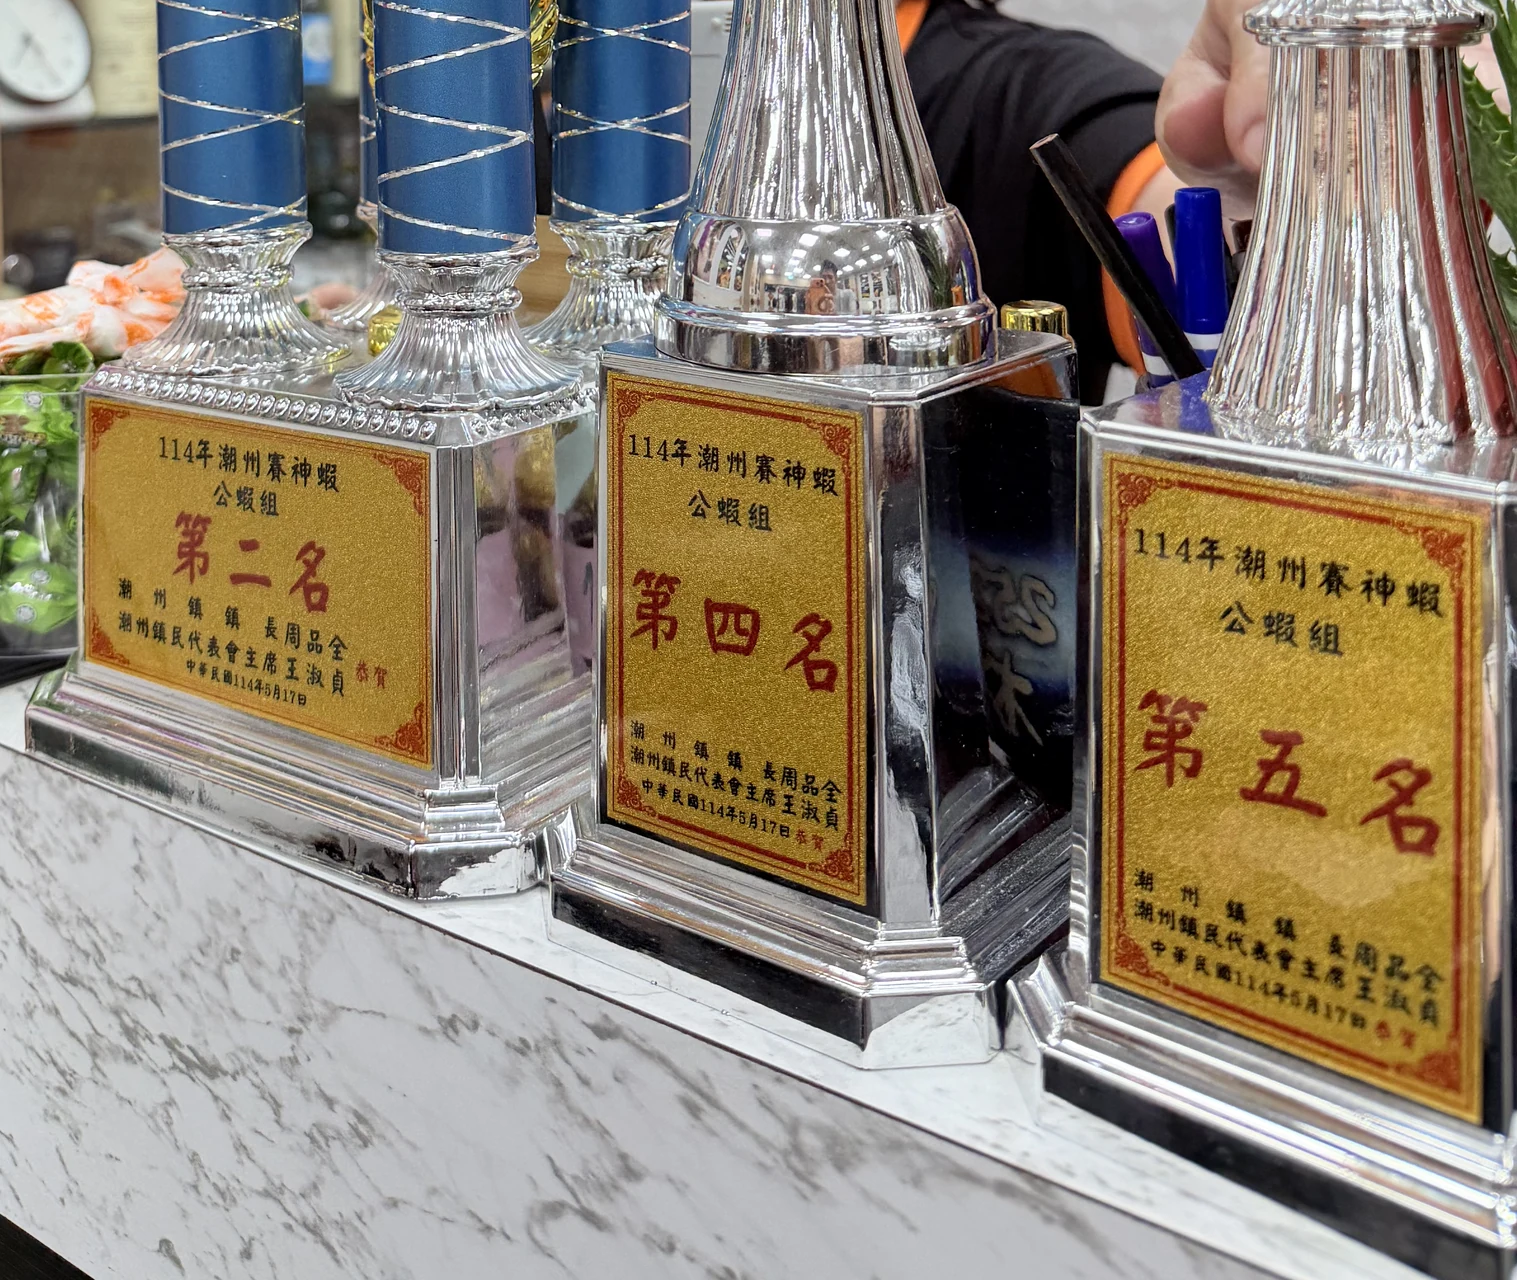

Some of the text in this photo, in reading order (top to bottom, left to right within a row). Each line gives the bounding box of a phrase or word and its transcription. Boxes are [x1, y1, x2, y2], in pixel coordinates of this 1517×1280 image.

[159, 436, 339, 493] 114年潮州賽神蝦
[628, 434, 838, 496] 114年潮州賽神蝦
[213, 481, 279, 516] 公蝦組
[688, 489, 772, 531] 公蝦組
[172, 510, 332, 613] 第二名
[1134, 528, 1444, 618] 114年潮州賽神蝦
[630, 570, 838, 693] 第四名
[1219, 600, 1343, 657] 公蝦組
[1134, 689, 1441, 857] 第五名
[642, 778, 791, 839] 中華民國114年5月17日
